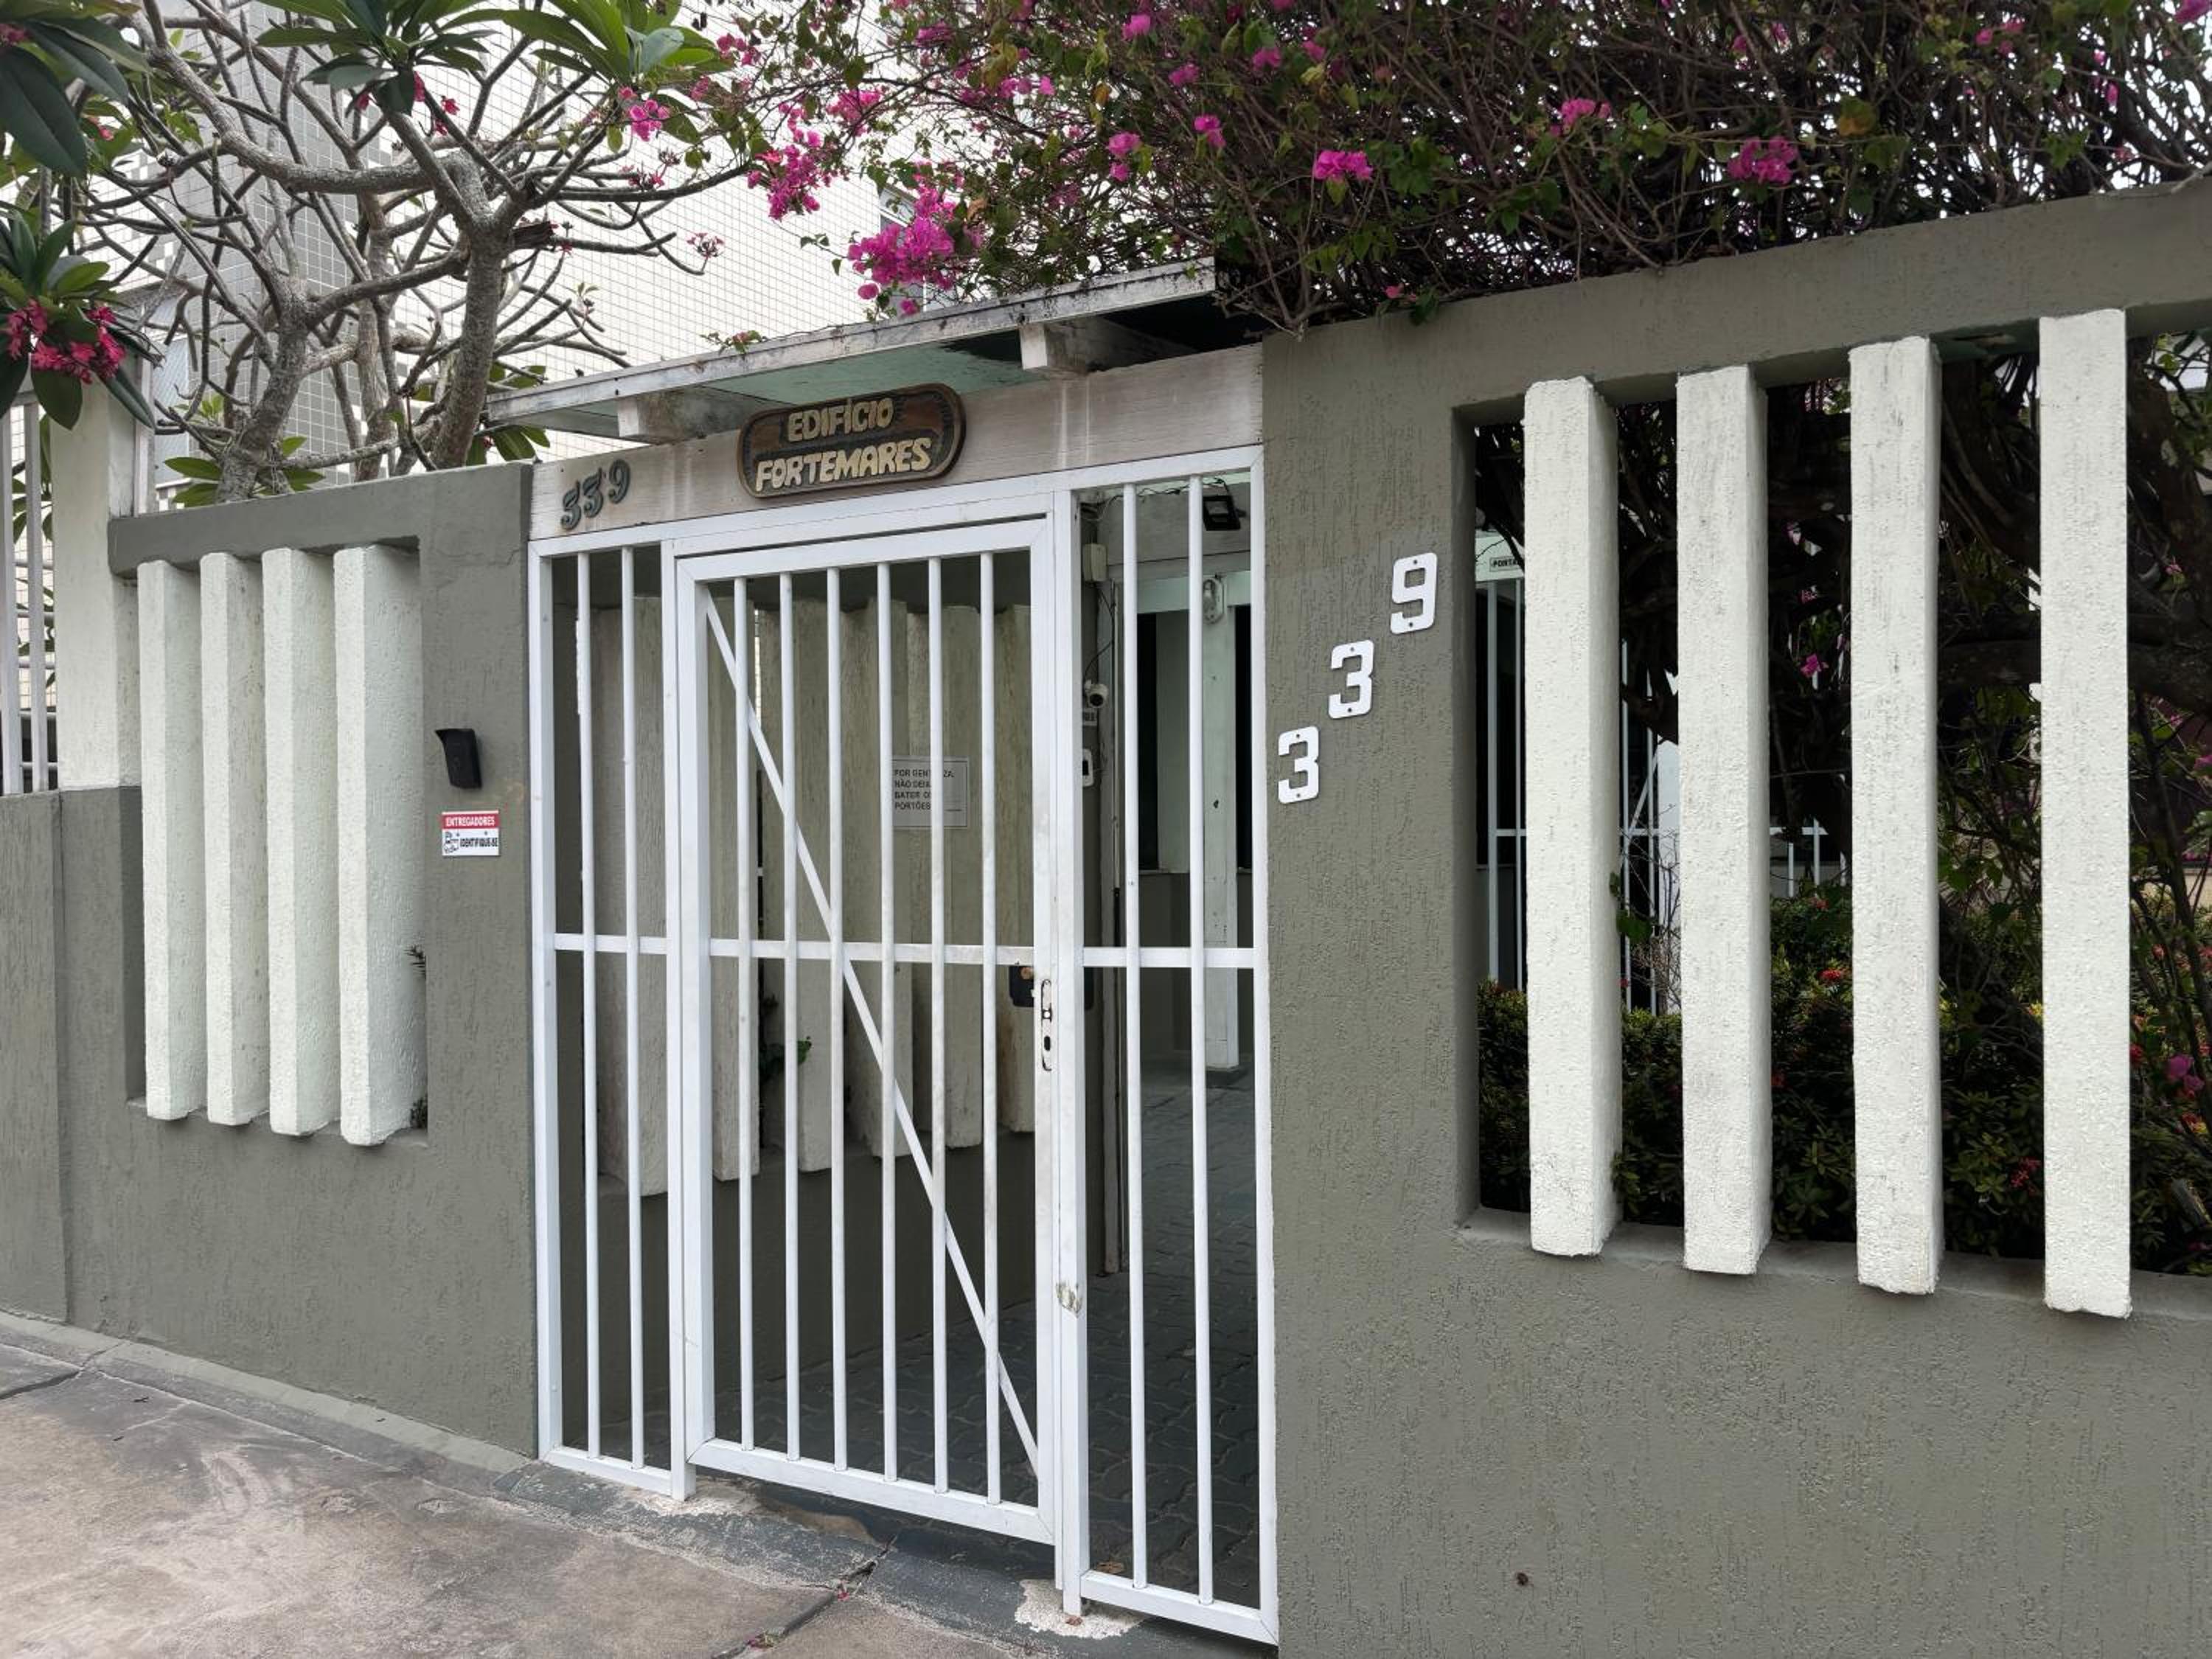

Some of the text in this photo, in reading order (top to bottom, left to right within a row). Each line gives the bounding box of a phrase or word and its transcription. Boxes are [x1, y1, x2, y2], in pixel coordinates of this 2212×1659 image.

[788, 398, 894, 442] EDIFÍCIO
[756, 438, 932, 492] FORTEMARES
[560, 459, 630, 530] 339
[894, 769, 911, 778] POR
[445, 815, 495, 827] ENTREGADORES
